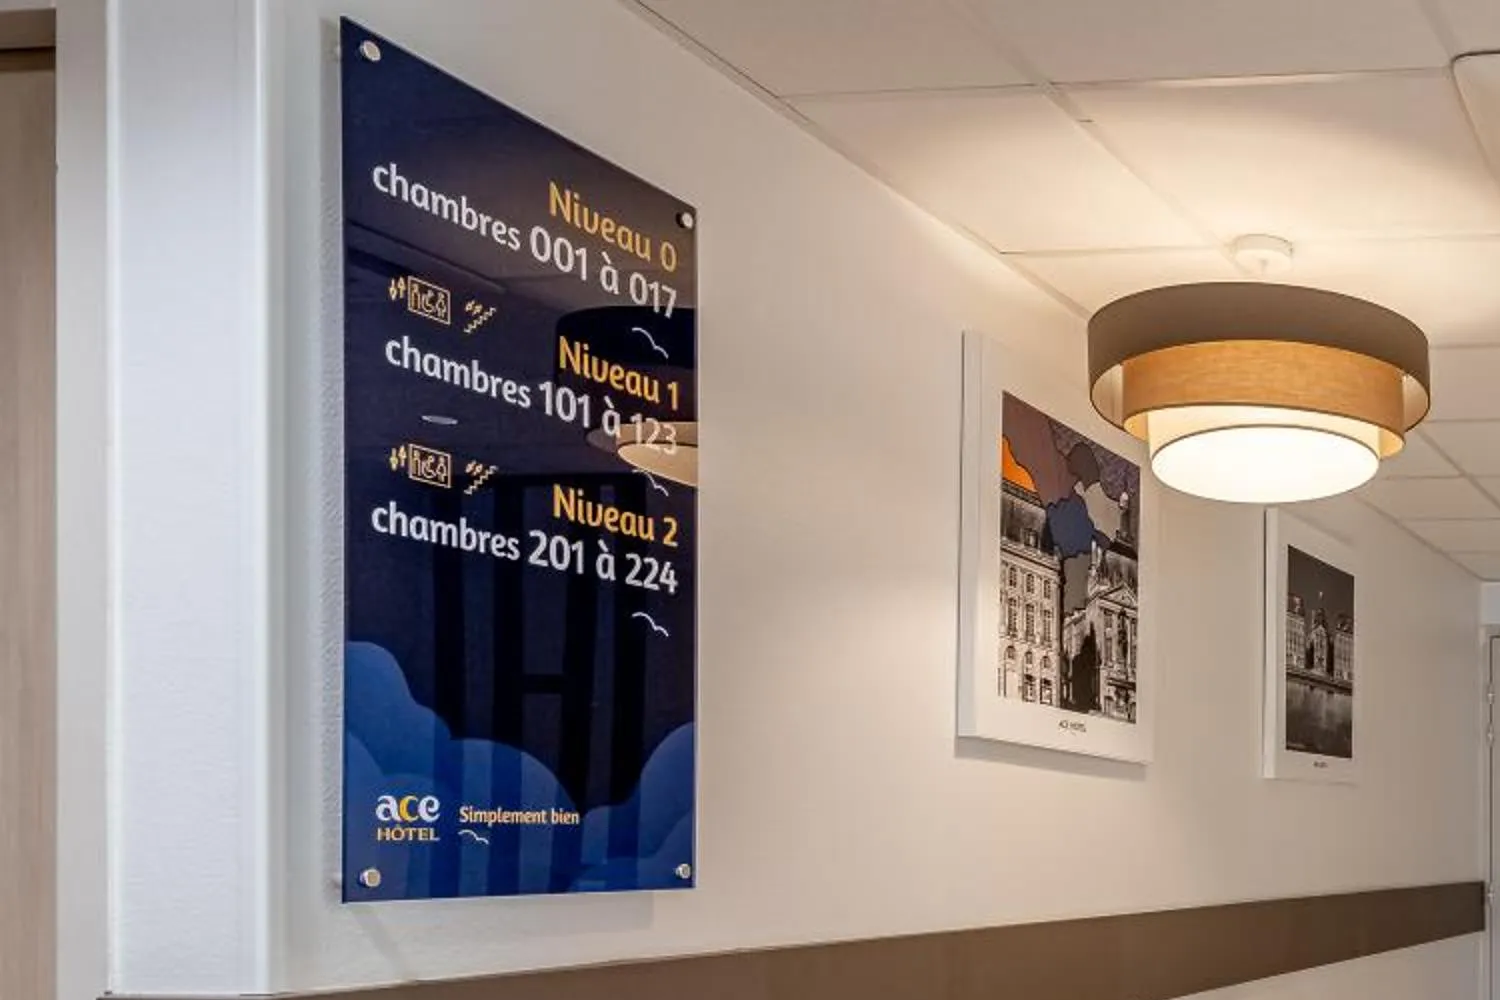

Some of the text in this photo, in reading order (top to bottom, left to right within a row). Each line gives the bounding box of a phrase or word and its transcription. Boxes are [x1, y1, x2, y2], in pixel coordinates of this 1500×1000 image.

[373, 163, 677, 319] chambres 001 à 017
[548, 181, 678, 273] Niveau 0
[385, 335, 677, 455] chambres 101 à 123
[558, 335, 678, 410] Niveau 1
[371, 502, 679, 596] chambres 201 à 224
[553, 484, 679, 548] Niveau 2
[375, 794, 441, 823] ace
[459, 805, 580, 827] Simplement bien
